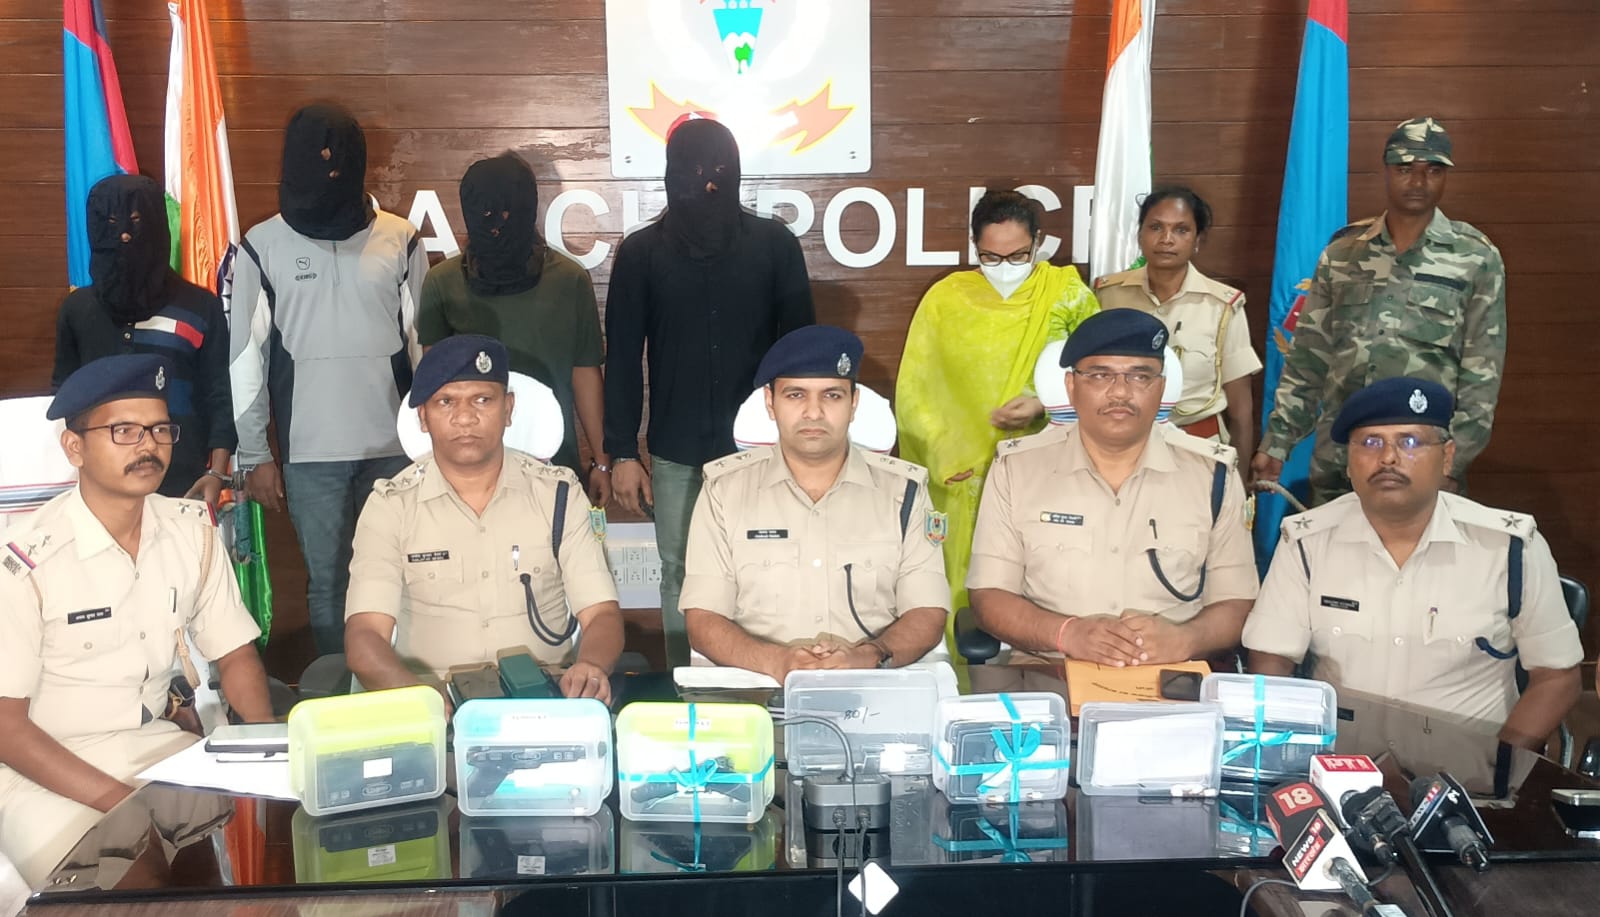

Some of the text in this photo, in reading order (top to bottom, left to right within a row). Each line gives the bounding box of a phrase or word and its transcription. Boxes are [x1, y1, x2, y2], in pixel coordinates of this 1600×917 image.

[1322, 757, 1371, 770] PTI
[1278, 787, 1313, 809] 18
[1291, 833, 1315, 867] NEWS
